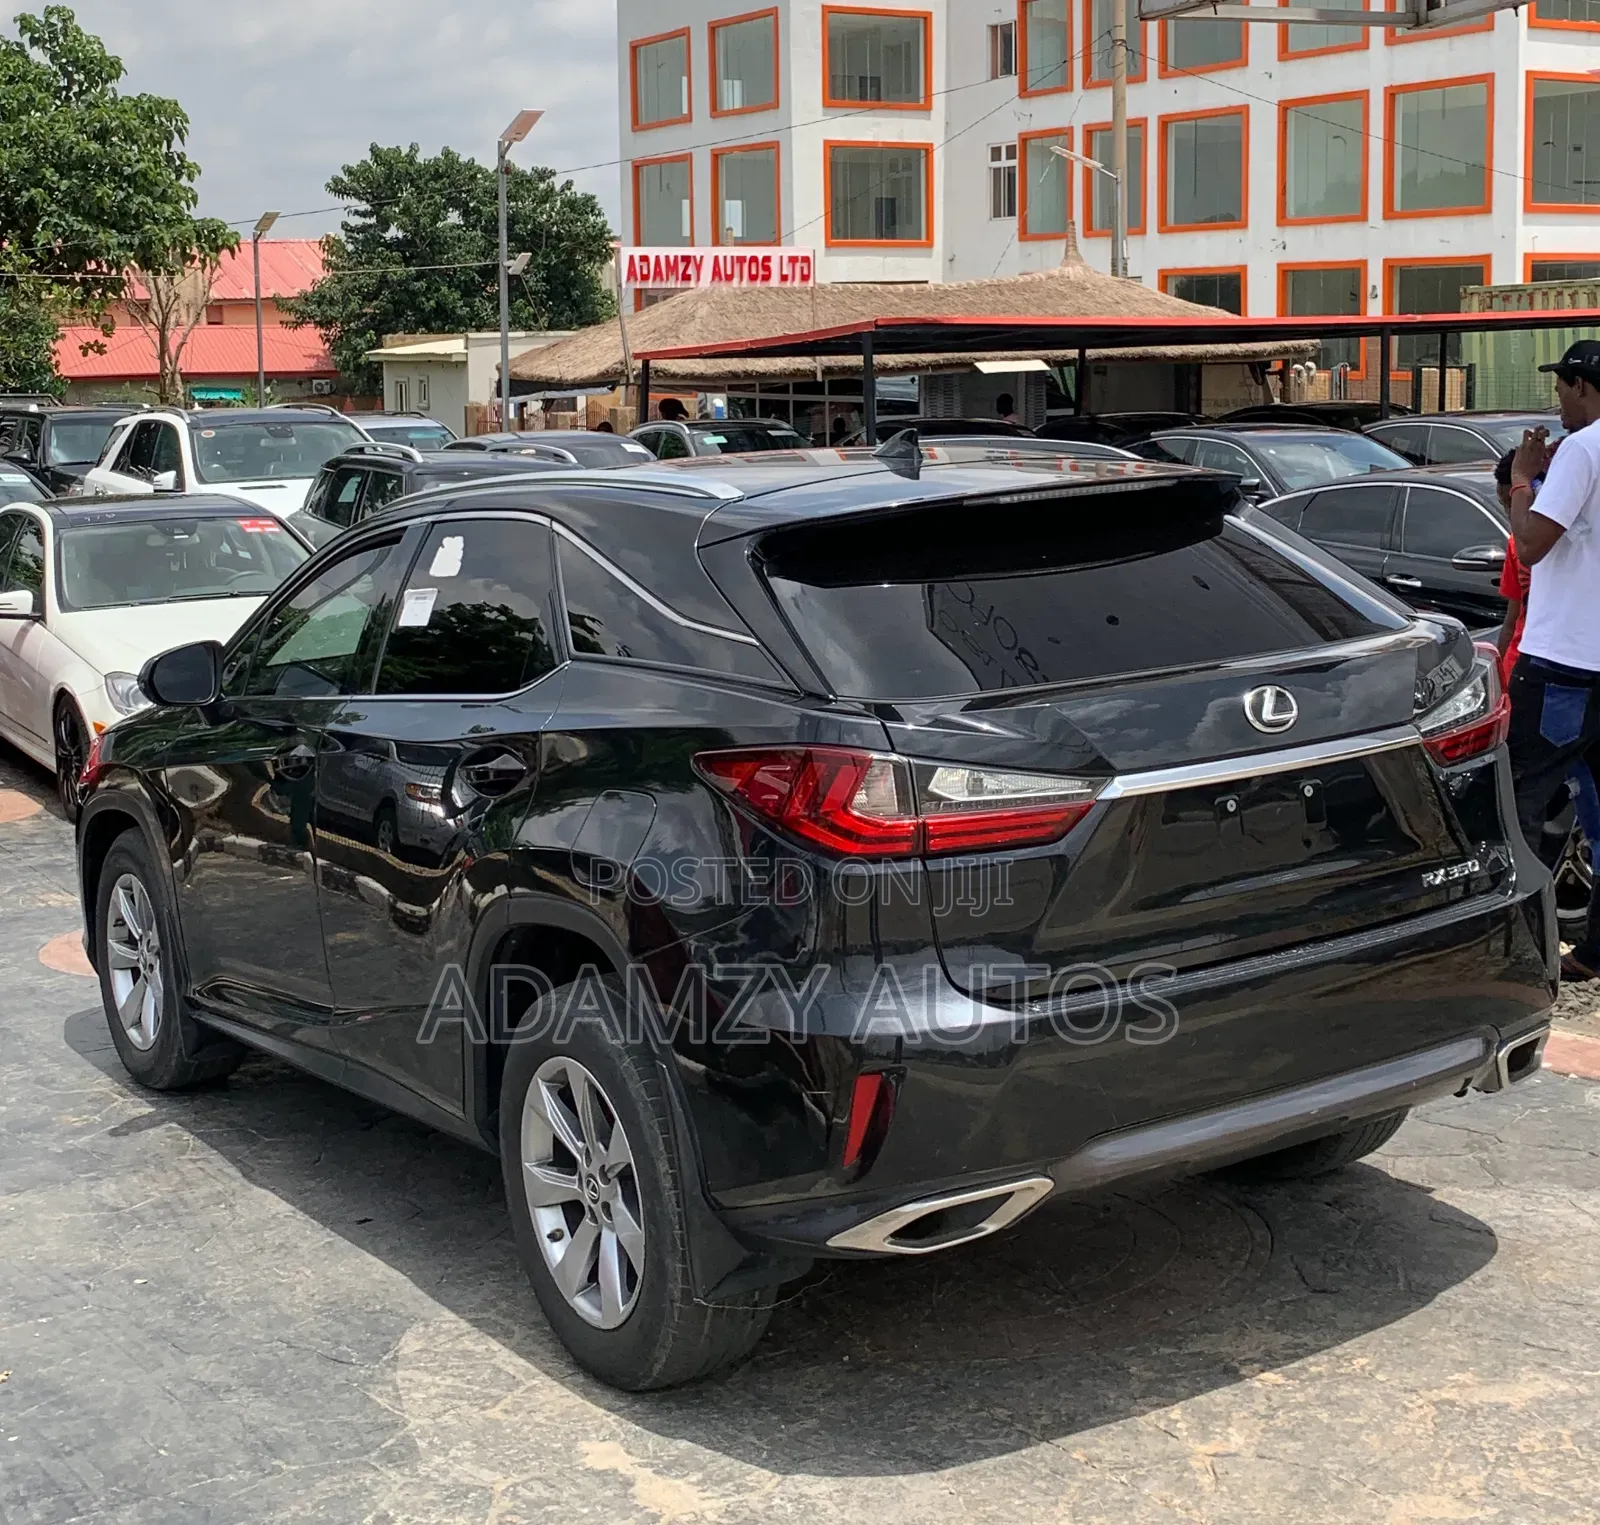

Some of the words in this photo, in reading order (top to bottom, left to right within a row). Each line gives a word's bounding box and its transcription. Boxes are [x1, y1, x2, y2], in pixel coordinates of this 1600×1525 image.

[626, 254, 704, 282] ADAMZY
[710, 254, 772, 282] AUTOS
[779, 254, 811, 282] LTD
[1421, 859, 1480, 888] RX350
